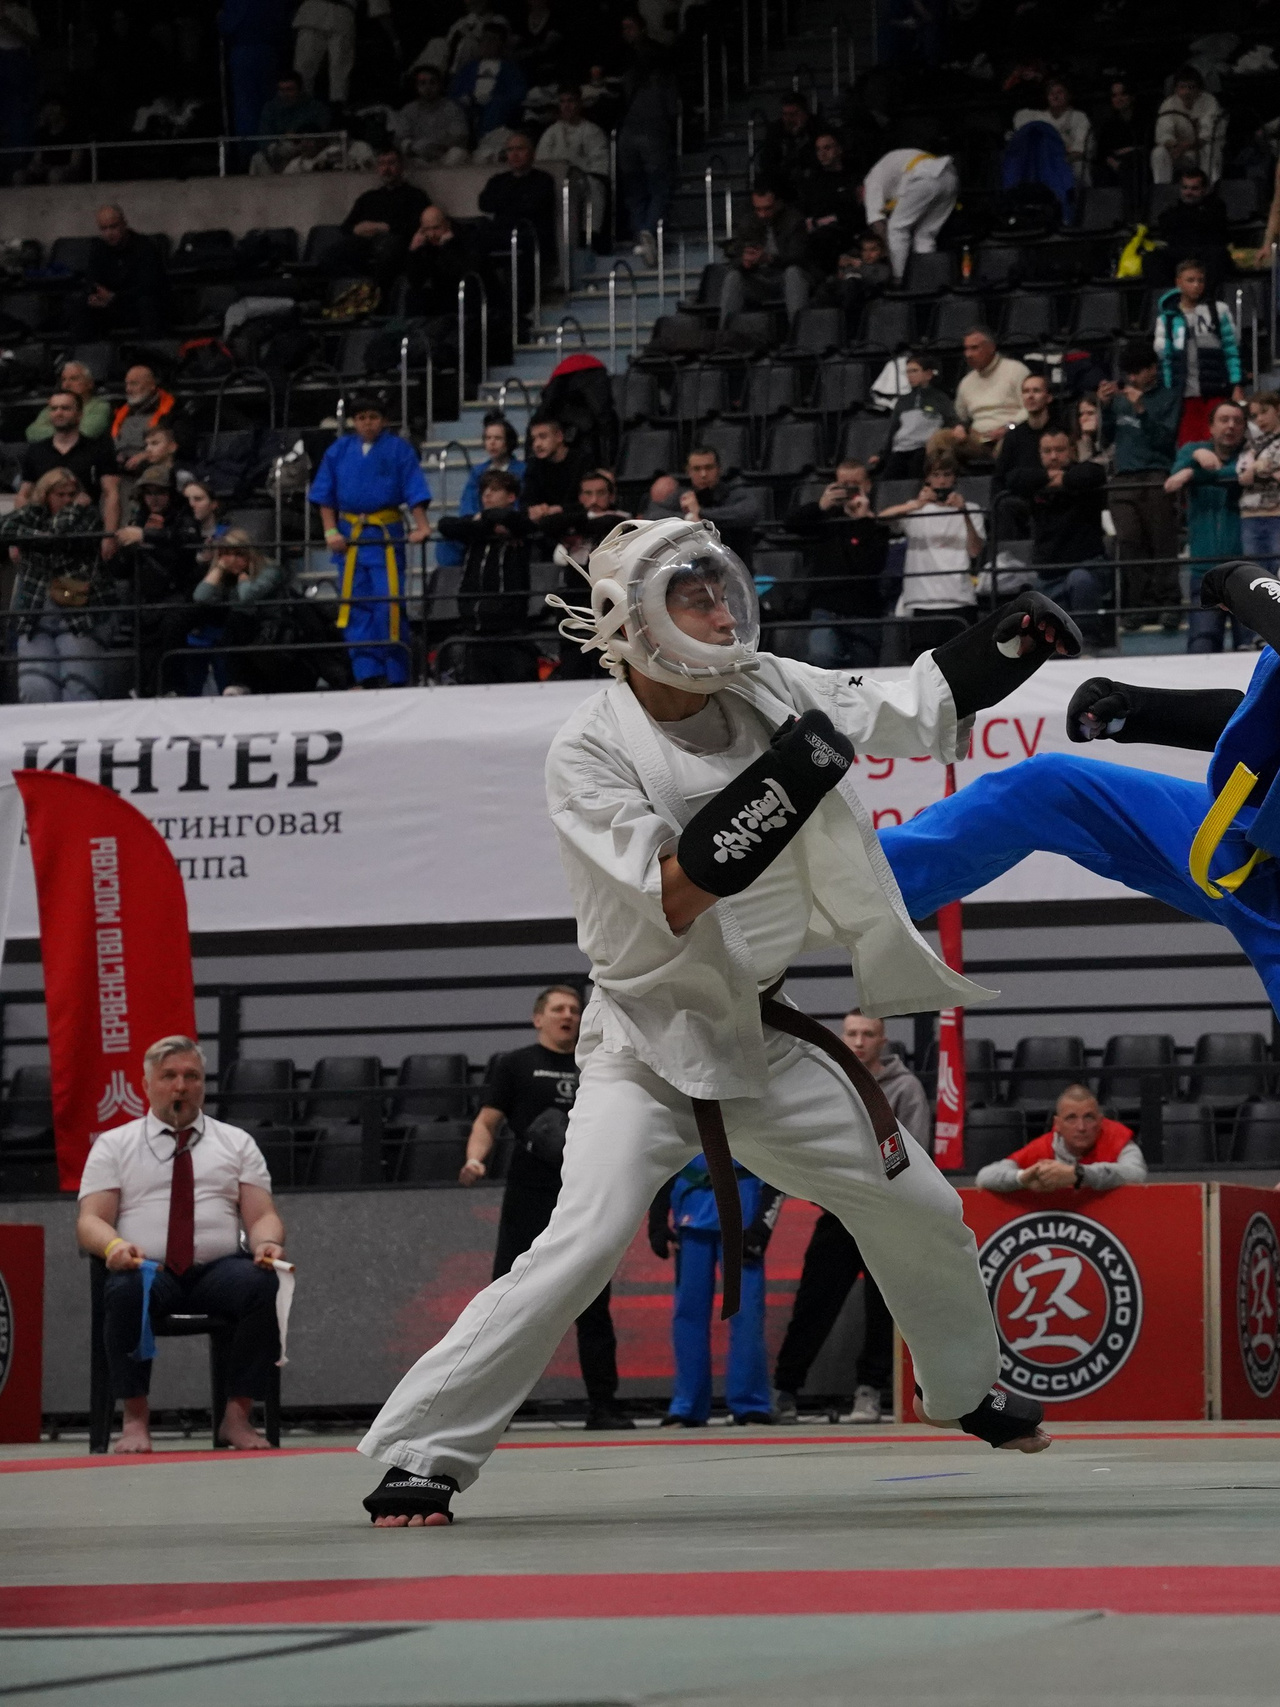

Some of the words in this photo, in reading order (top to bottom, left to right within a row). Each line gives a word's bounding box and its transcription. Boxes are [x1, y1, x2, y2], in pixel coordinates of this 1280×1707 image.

[90, 836, 122, 923] МОСКВЫ
[96, 928, 130, 1054] ПЕРВЕНСТВО
[980, 1222, 1097, 1287] ДЕРАЦИЯ
[1099, 1246, 1131, 1327] КУДО
[1000, 1352, 1110, 1390] РОССИИ
